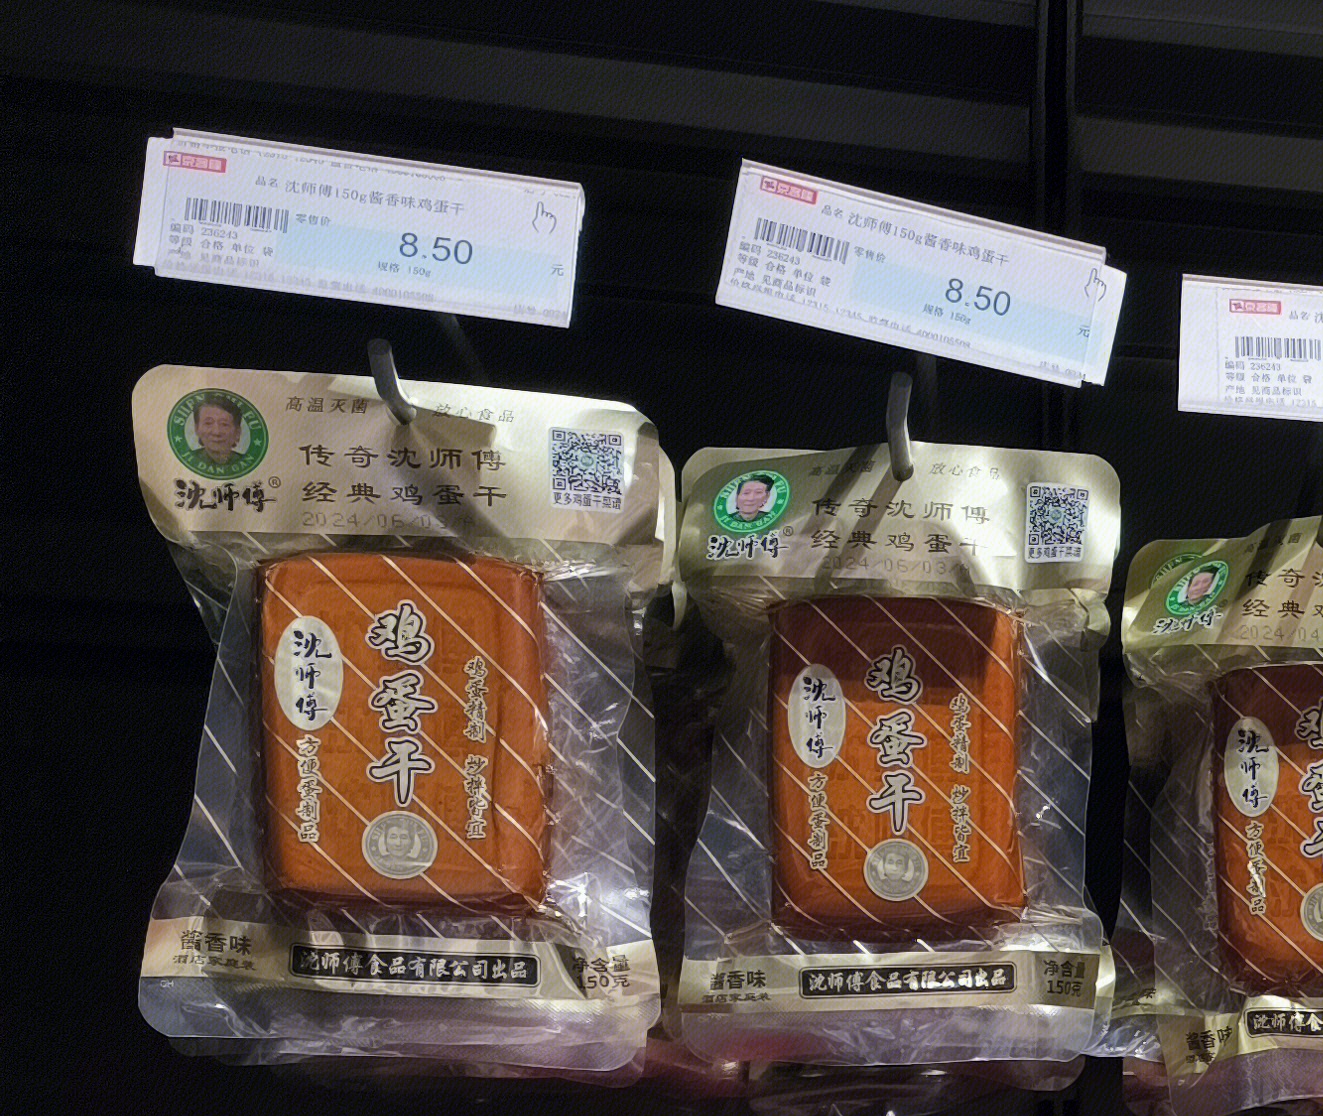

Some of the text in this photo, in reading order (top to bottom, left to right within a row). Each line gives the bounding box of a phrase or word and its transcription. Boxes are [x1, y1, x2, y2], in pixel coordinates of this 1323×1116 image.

[399, 232, 474, 265] 8.50
[945, 277, 1011, 317] 8.50
[285, 395, 369, 416] 高温灭菌
[432, 402, 516, 425] 放心食品
[299, 443, 506, 472] 传奇沈师傅
[301, 480, 508, 508] 经典鸡蛋干
[811, 499, 990, 525] 传奇沈师傅
[811, 529, 989, 556] 经典鸡蛋干
[367, 602, 437, 806] 鸡蛋干
[866, 646, 927, 834] 鸡蛋干
[296, 734, 321, 844] 方便蛋制品
[808, 969, 1007, 992] 沈师傅食品有限公司出品
